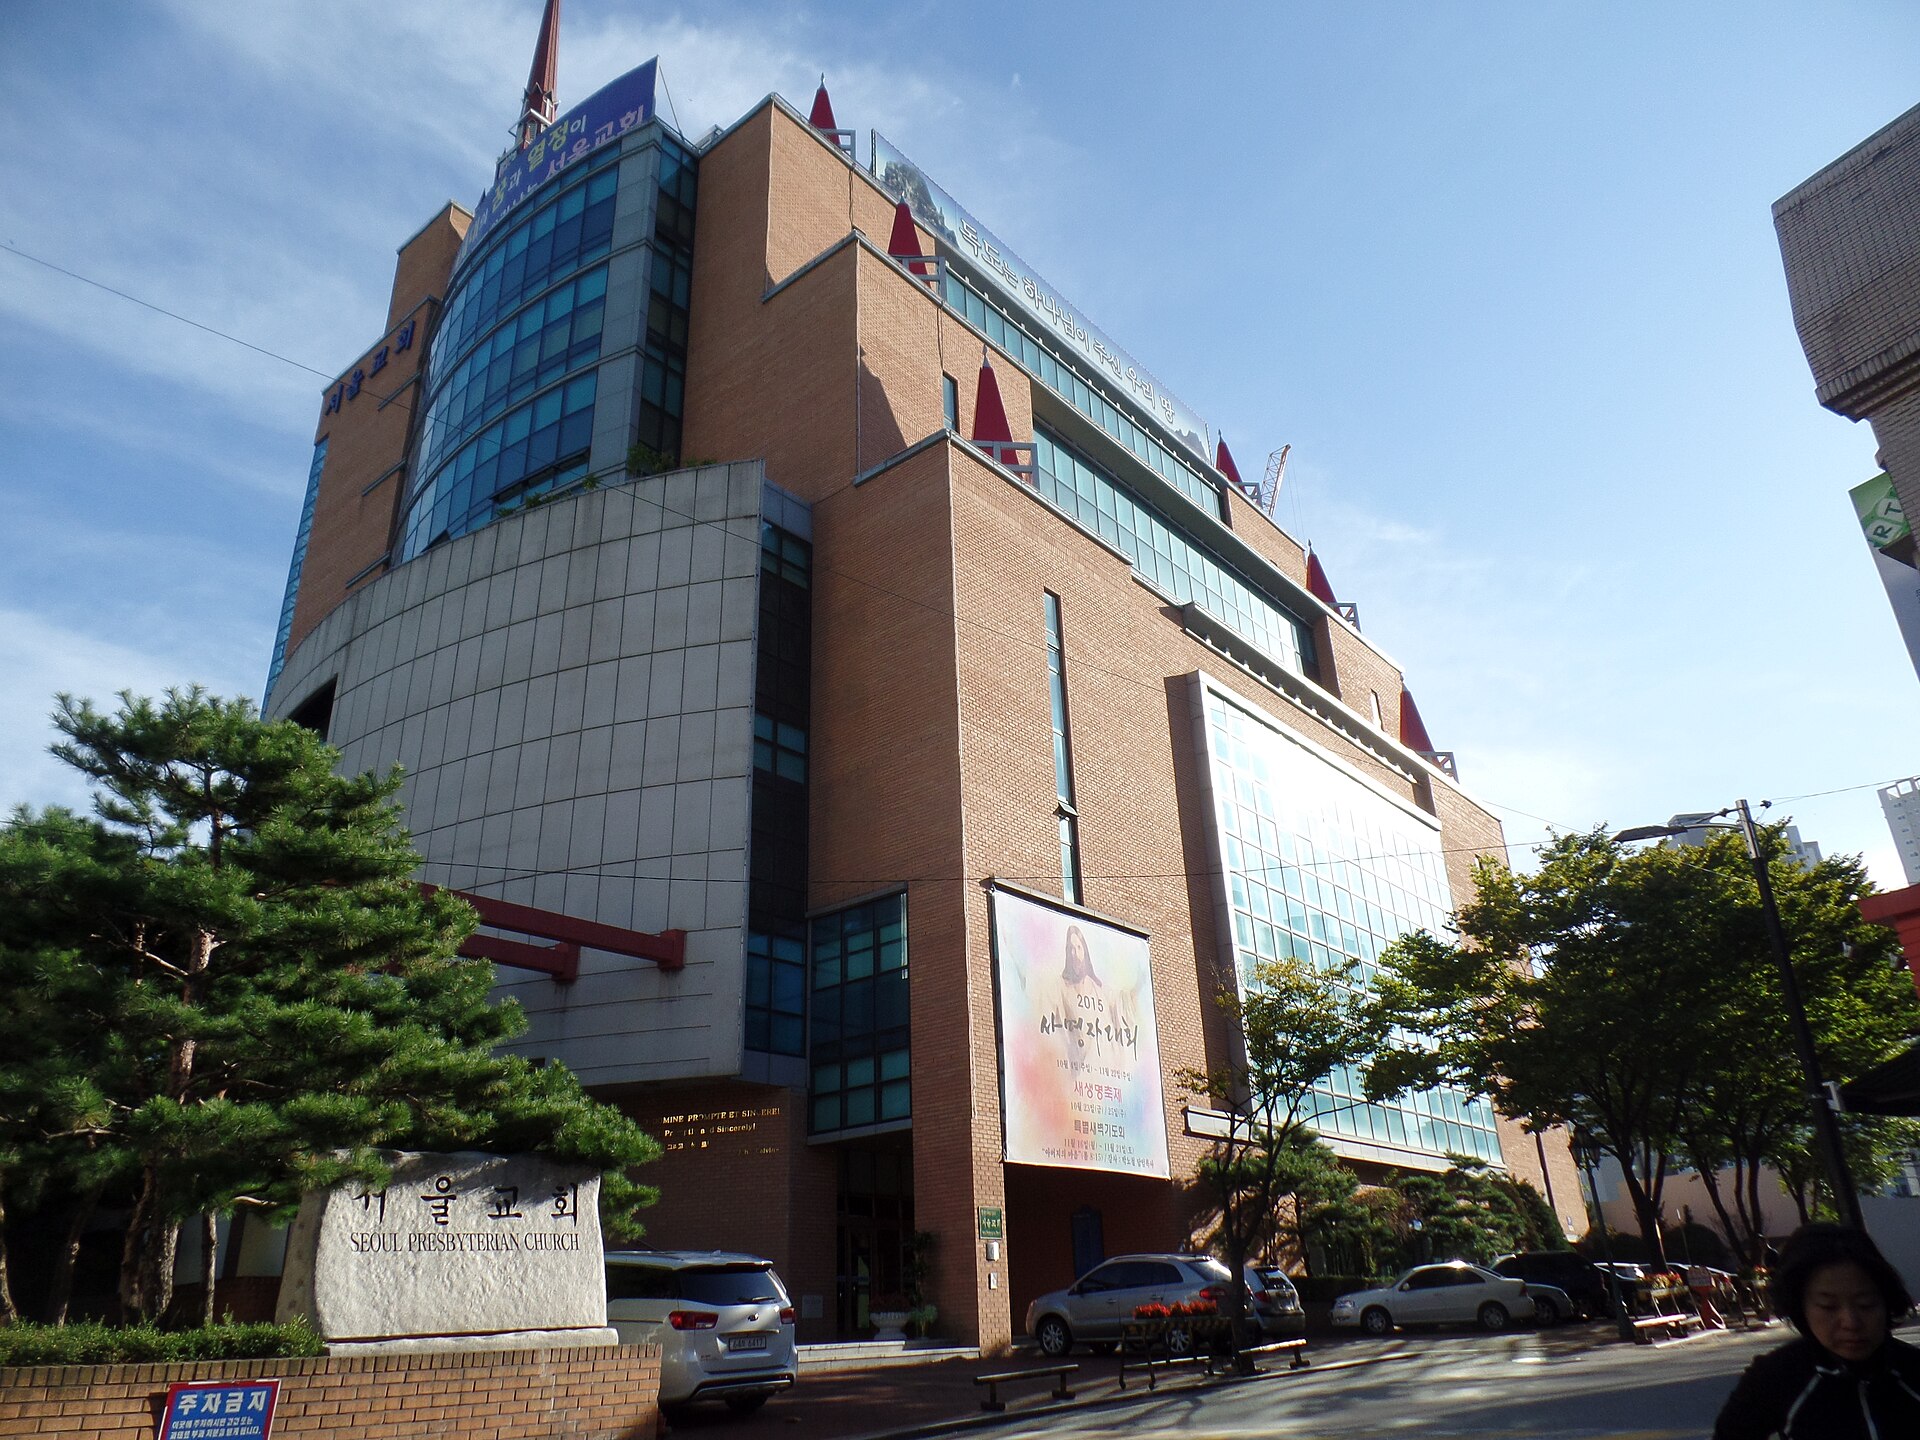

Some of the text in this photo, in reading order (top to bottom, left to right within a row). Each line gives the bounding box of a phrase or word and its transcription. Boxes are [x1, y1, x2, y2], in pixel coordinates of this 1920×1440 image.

[527, 114, 587, 173] 열정이
[545, 104, 644, 181] 서울교회
[959, 218, 1175, 424] 독도는 하나님이 주신 우리 땅
[325, 319, 416, 416] 서울교회
[1076, 993, 1104, 1013] 2015
[1040, 1011, 1138, 1062] 사명자대회
[1074, 1080, 1123, 1104] 새생명축제
[741, 1107, 780, 1118] SINERE!
[1074, 1120, 1126, 1140] 특별새벽기도회
[350, 1232, 580, 1252] SEOUL PRESBYTERIAN CHURCH
[178, 1390, 267, 1415] 주차금지
